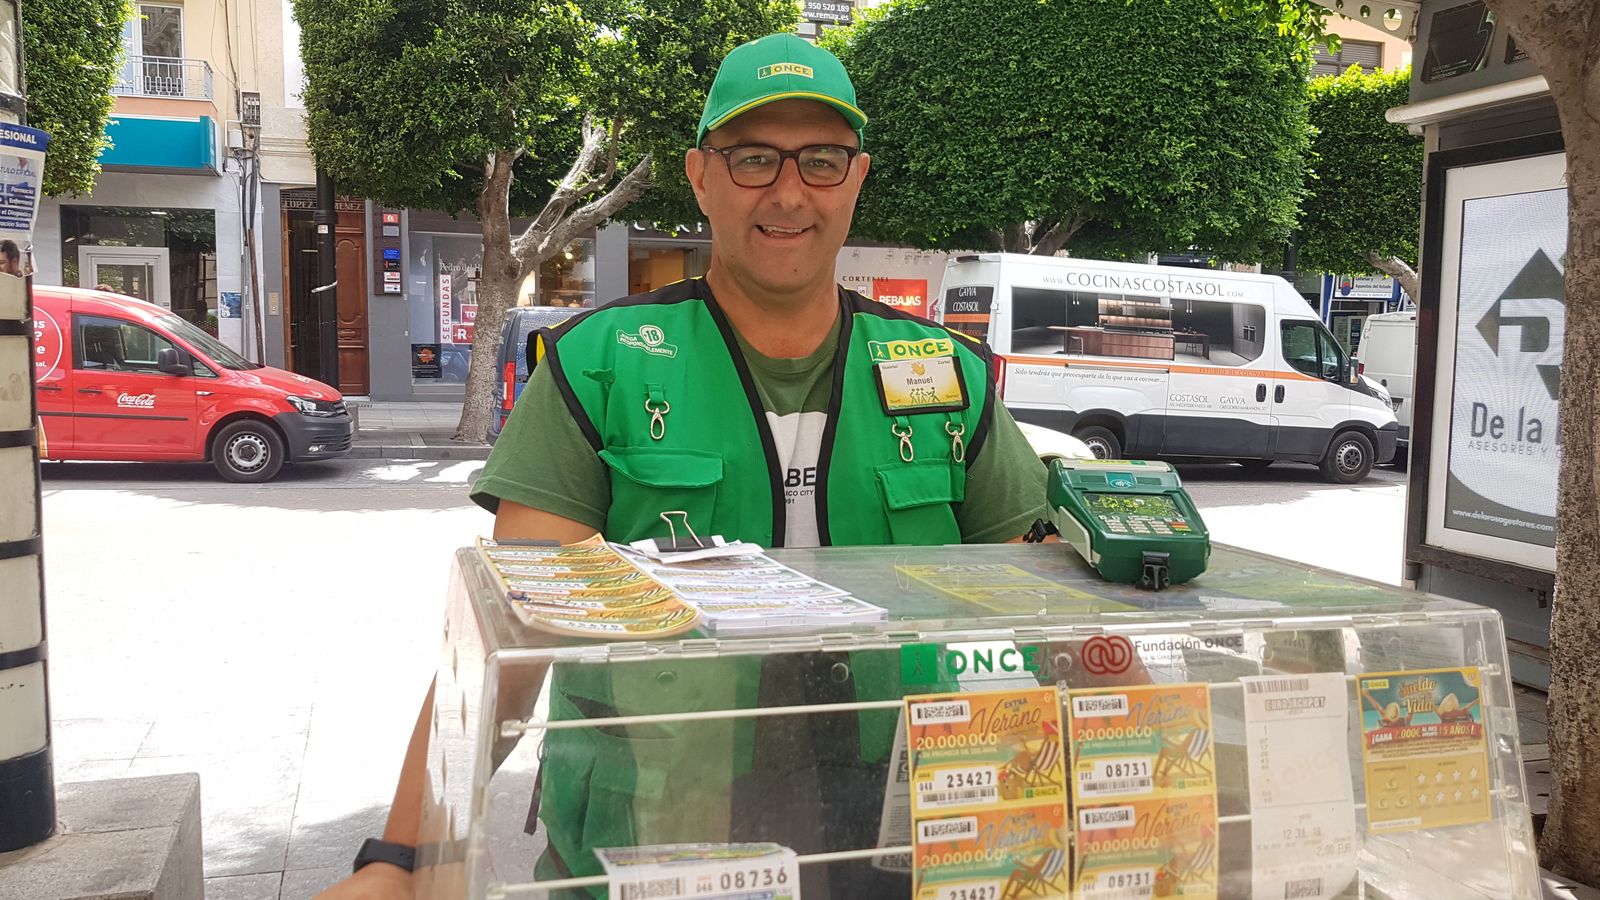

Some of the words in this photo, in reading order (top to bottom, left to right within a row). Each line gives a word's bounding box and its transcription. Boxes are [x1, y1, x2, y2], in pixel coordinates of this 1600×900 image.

[808, 2, 821, 10] 950
[774, 65, 810, 76] ONCE
[879, 295, 922, 306] REBAJAS
[952, 301, 979, 312] COSTASOL
[442, 278, 450, 340] SEGUNDAS
[893, 341, 949, 356] ONCE
[906, 376, 933, 386] Manuel
[1062, 371, 1097, 379] preocuparte
[1169, 393, 1209, 403] COSTASOL
[1219, 395, 1246, 404] GAYVA
[1471, 402, 1505, 440] De
[1518, 406, 1542, 444] la
[1468, 441, 1532, 456] ASESORES
[945, 645, 1040, 676] ONCE
[1134, 637, 1201, 653] Fundación
[1204, 635, 1244, 649] ONCE
[1400, 677, 1437, 698] Sueldo
[1003, 698, 1028, 709] EXTRA
[1264, 695, 1327, 711] EUROJACKPOT
[1404, 696, 1434, 714] Vida
[967, 698, 1041, 741] Verano
[916, 732, 998, 750] 20.000.000
[1372, 732, 1393, 745] ¡GANA
[1106, 762, 1148, 778] 08731
[946, 771, 992, 789] 23427
[720, 866, 788, 890] 08736
[1108, 871, 1150, 889] 08731
[950, 886, 996, 900] 23427
